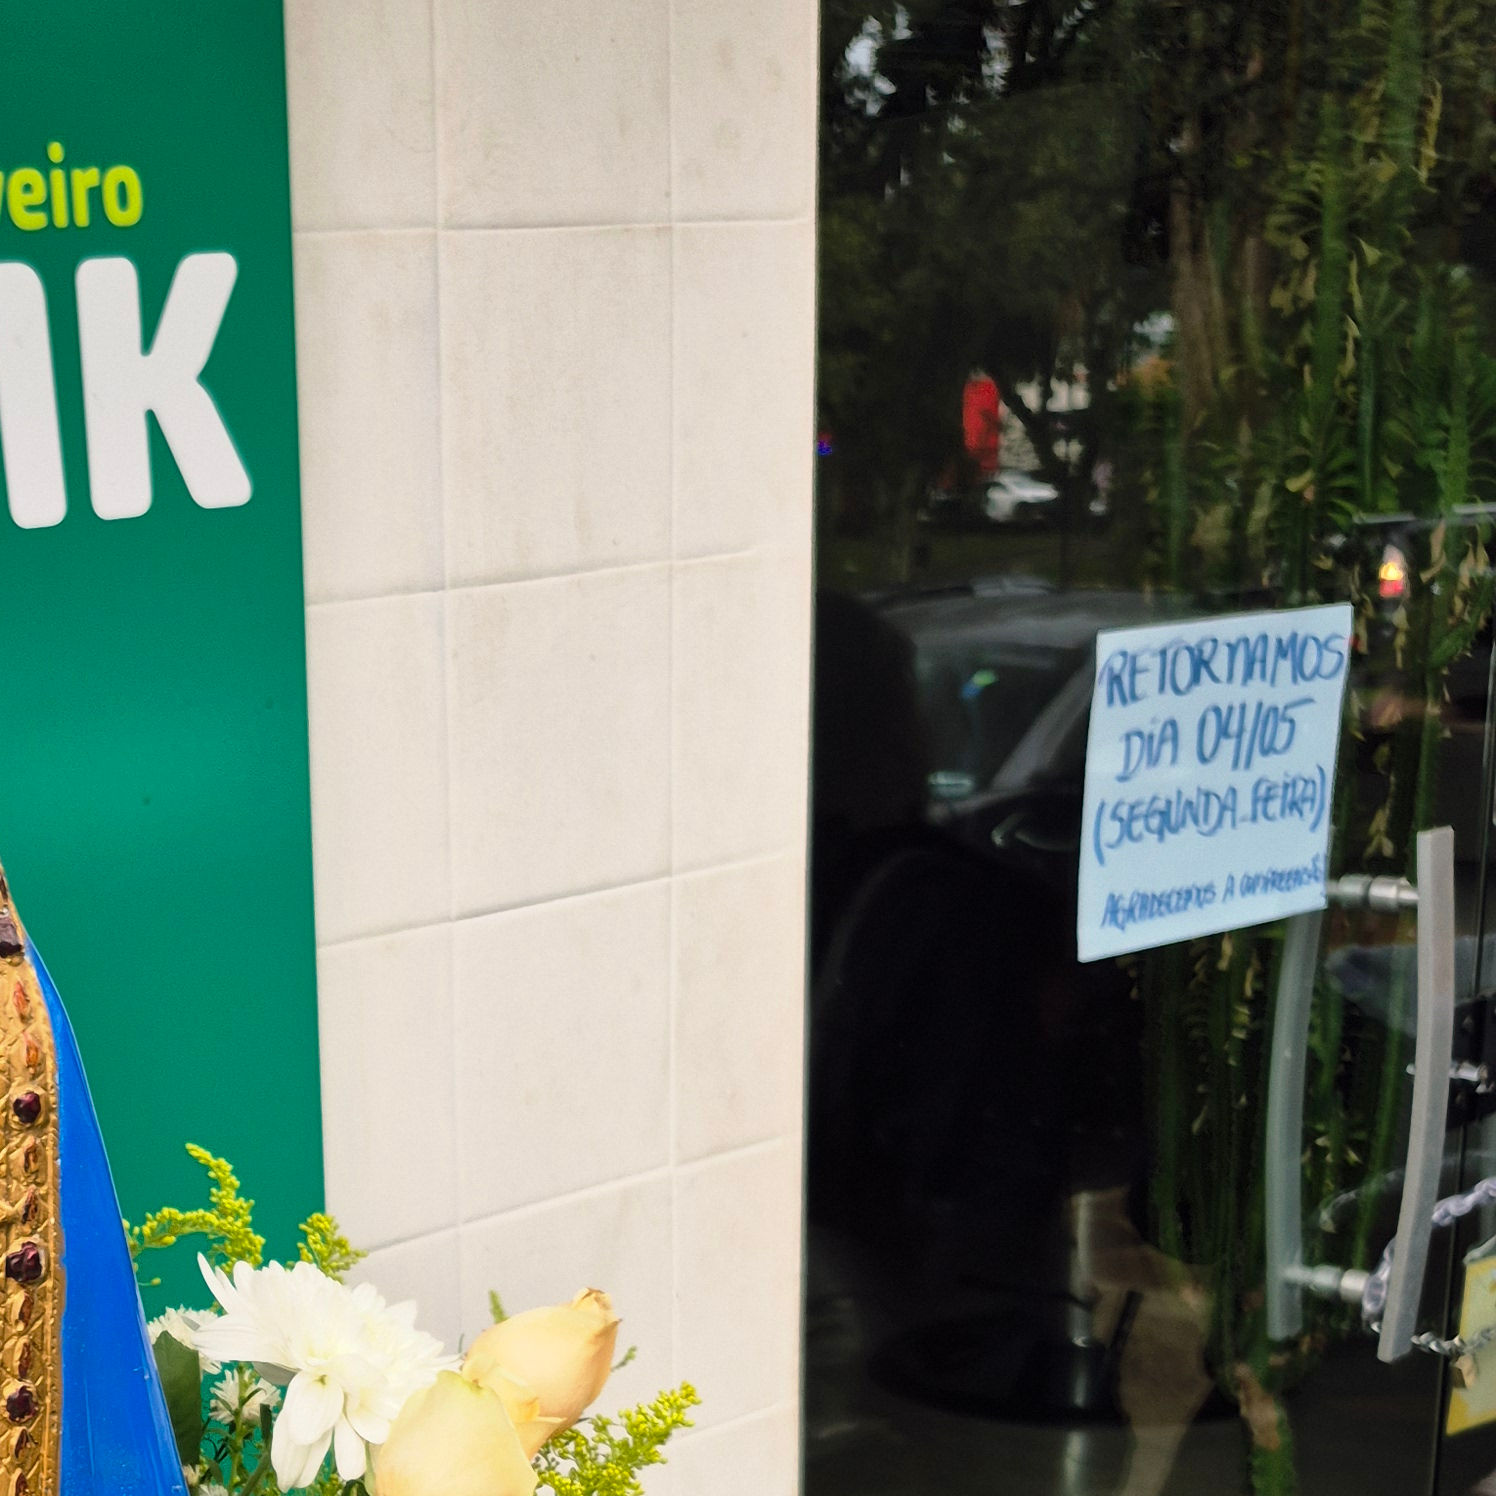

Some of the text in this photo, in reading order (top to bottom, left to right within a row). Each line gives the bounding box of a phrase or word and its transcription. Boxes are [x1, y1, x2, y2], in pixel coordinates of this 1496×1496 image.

[1097, 631, 1346, 708] RETORNAMOS
[1196, 697, 1316, 771] 04/05
[1222, 872, 1236, 902] A
